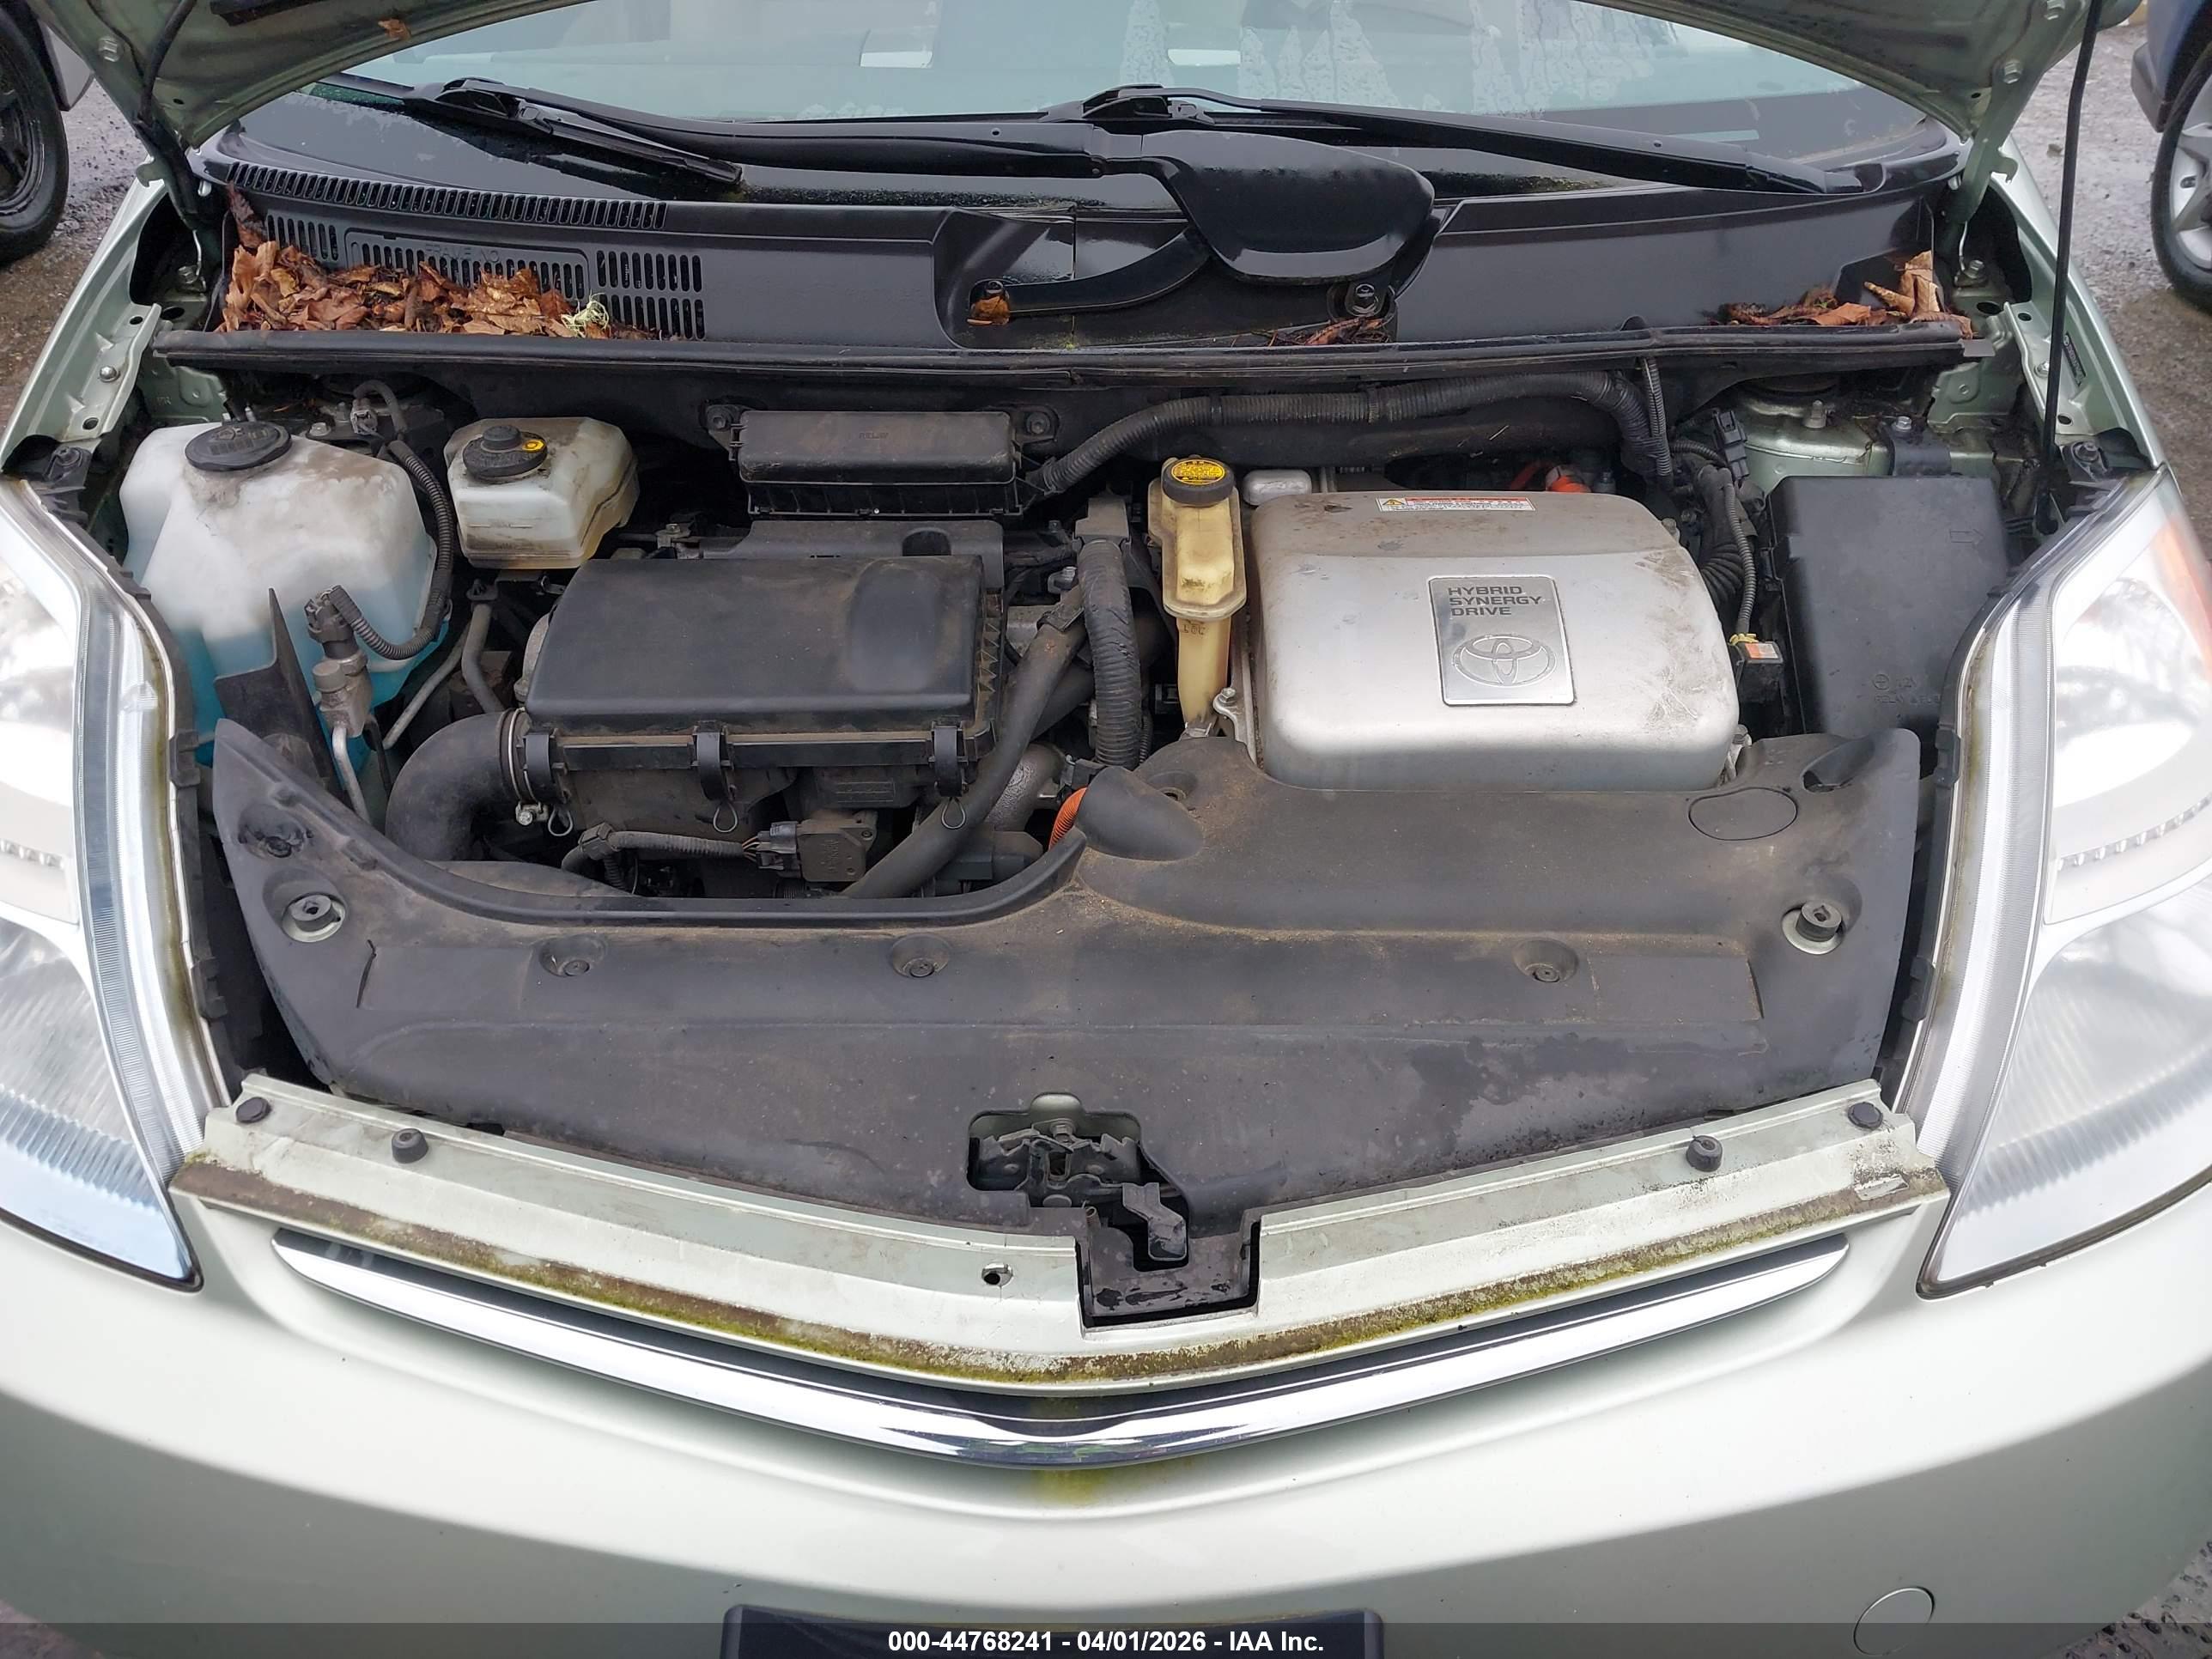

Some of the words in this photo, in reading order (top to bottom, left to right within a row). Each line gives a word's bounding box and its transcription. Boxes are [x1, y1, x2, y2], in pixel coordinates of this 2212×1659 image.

[425, 244, 472, 260] FRAME
[1448, 586, 1522, 596] HYBRID
[1449, 596, 1542, 606] SYNERGY
[1451, 606, 1512, 617] DRIVE
